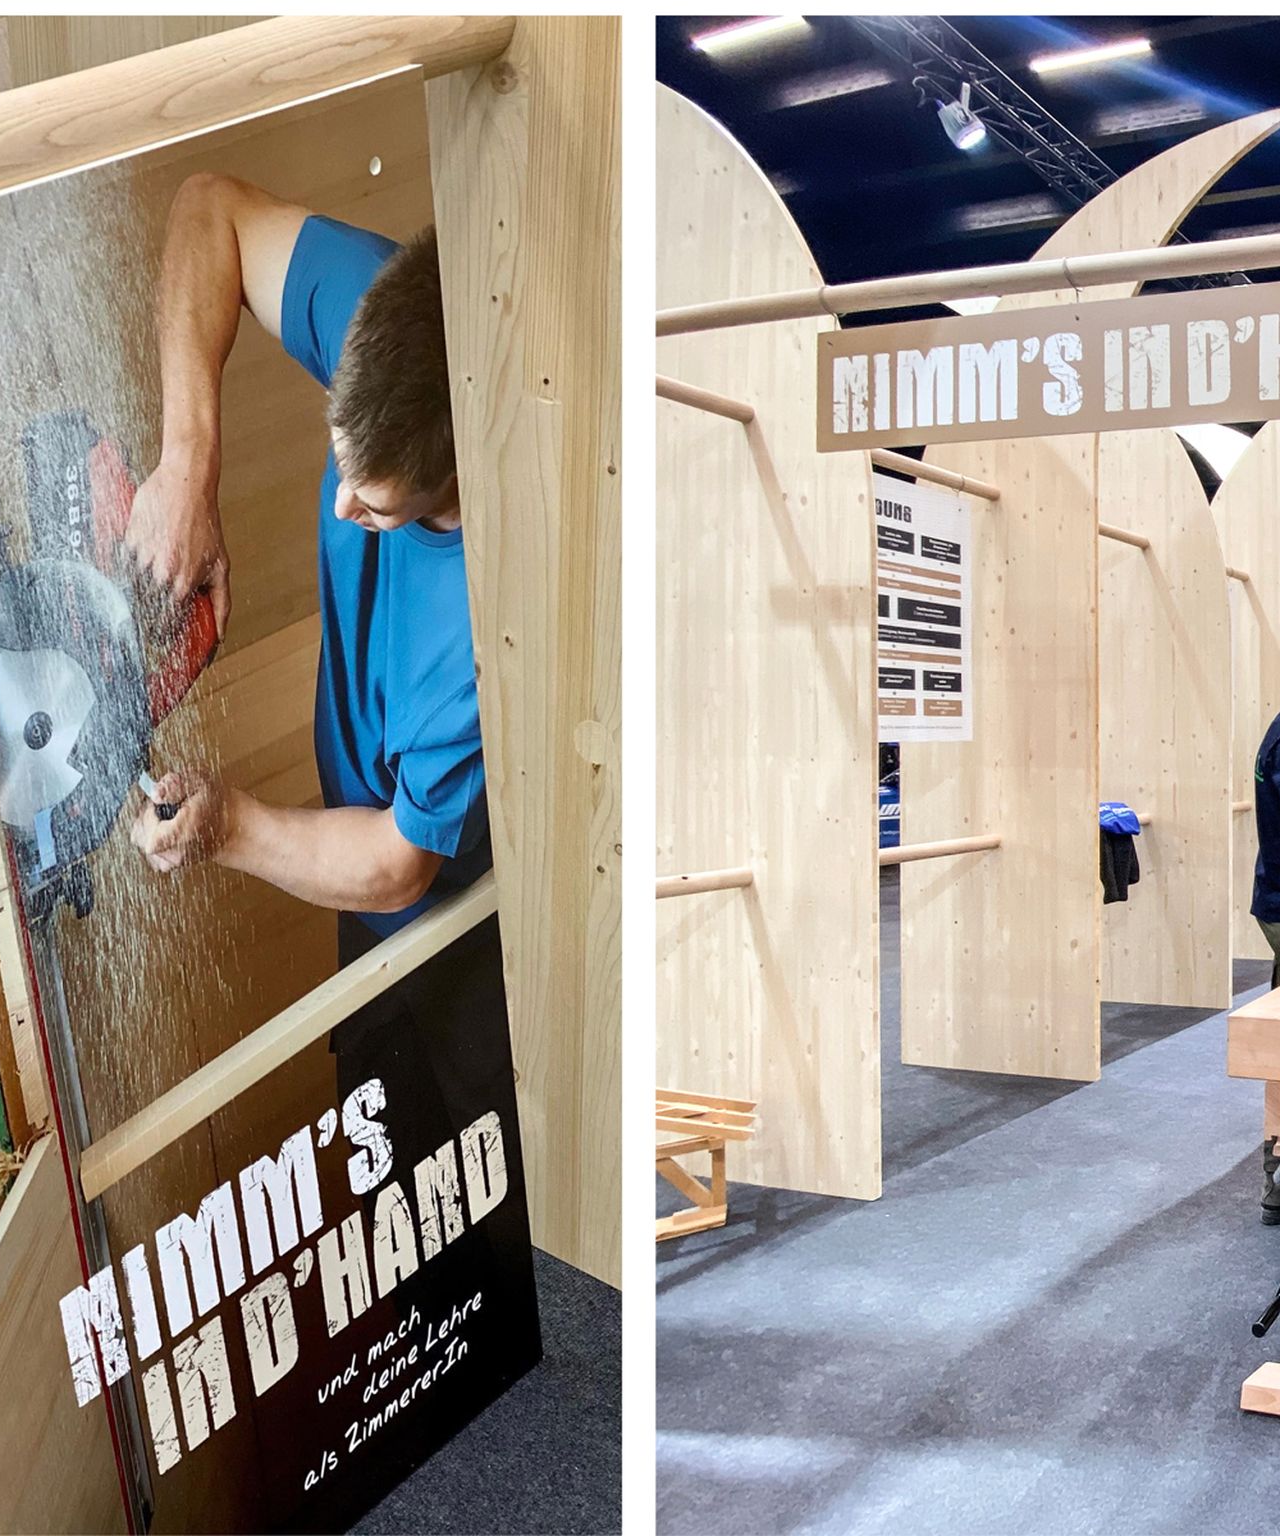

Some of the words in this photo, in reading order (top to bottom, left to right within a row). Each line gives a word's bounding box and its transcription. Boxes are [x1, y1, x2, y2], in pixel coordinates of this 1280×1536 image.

[832, 332, 1084, 435] NIMM'S
[1104, 324, 1172, 412] IN
[58, 1077, 393, 1408] NIMM'S
[141, 1315, 237, 1476] IN
[239, 1110, 509, 1397] D'HAND
[304, 1451, 339, 1491] als
[344, 1336, 468, 1453] ZimmererIn
[318, 1353, 359, 1404] und
[367, 1305, 421, 1366] mach
[363, 1345, 418, 1403] deine
[425, 1292, 482, 1352] Lehre
